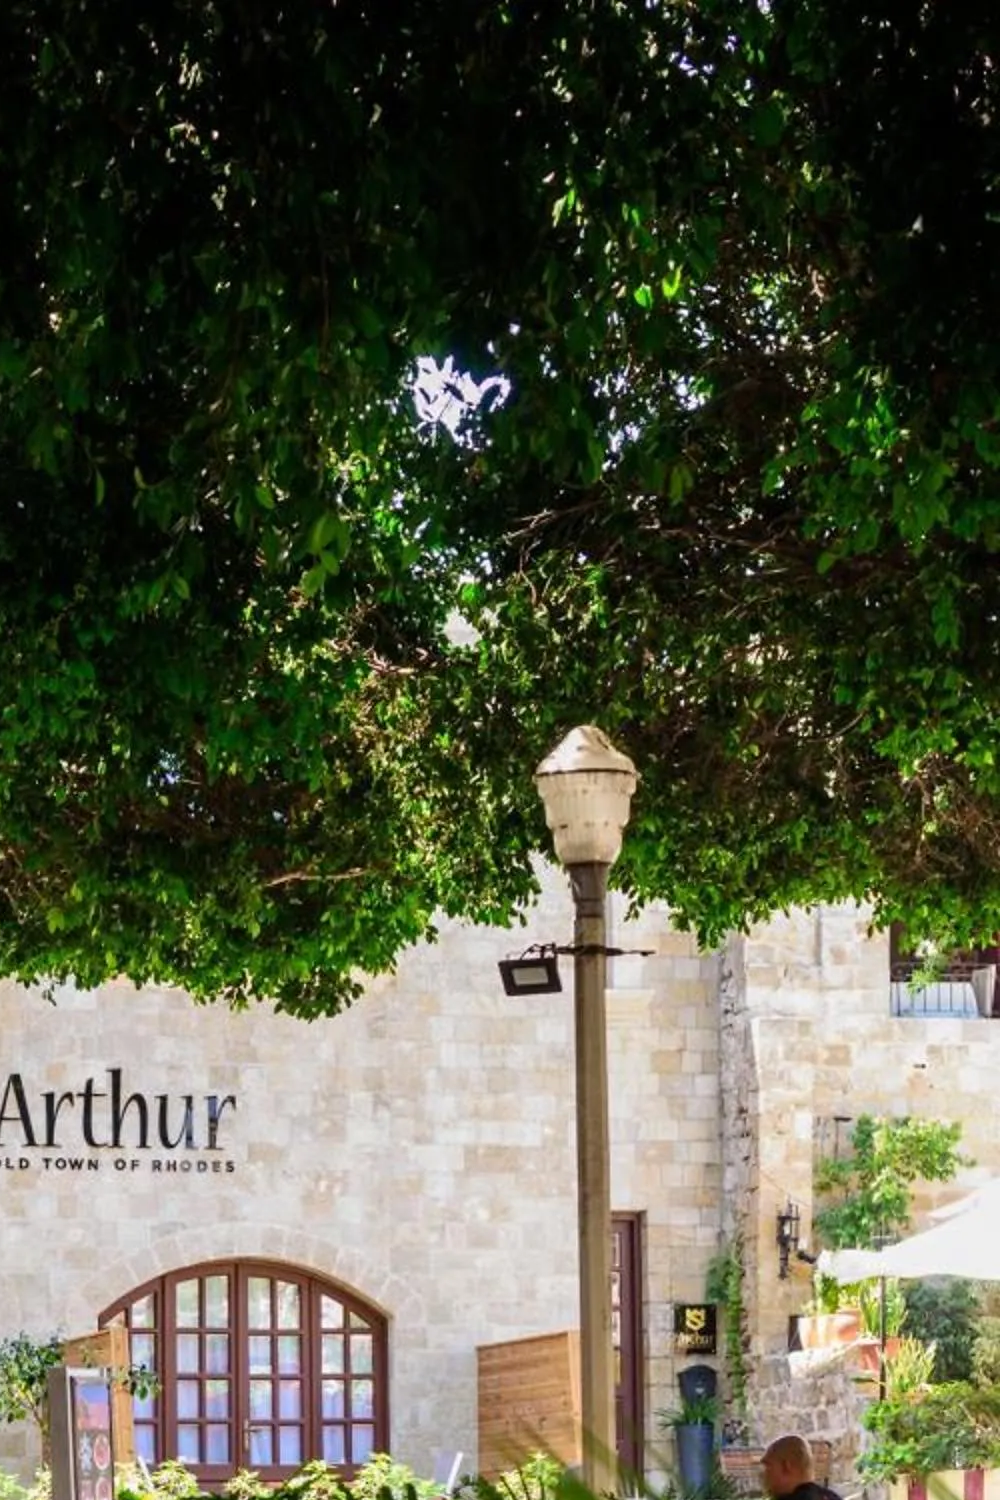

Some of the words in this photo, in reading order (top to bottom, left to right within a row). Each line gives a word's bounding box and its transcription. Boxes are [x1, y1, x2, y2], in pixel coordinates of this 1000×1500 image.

[43, 1158, 99, 1171] TOWN
[115, 1158, 140, 1171] OF
[152, 1159, 235, 1173] RHODES
